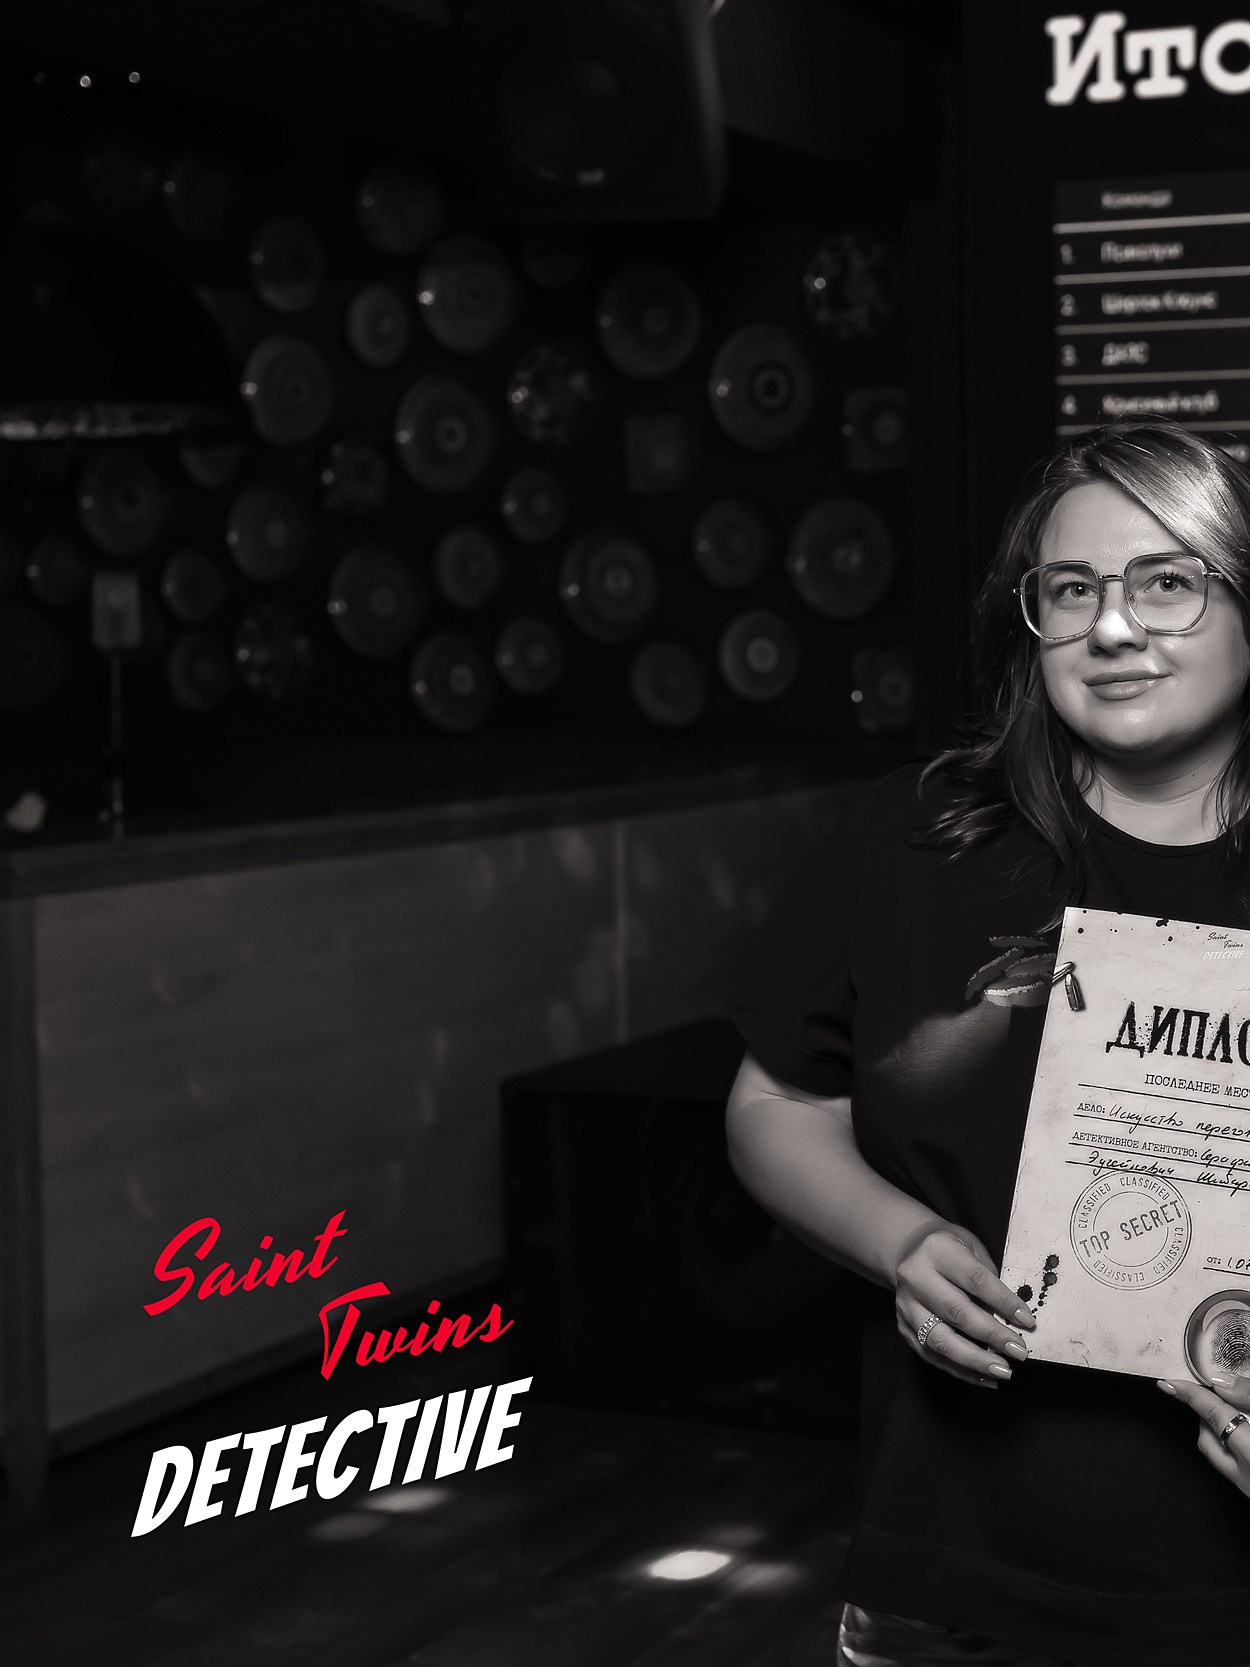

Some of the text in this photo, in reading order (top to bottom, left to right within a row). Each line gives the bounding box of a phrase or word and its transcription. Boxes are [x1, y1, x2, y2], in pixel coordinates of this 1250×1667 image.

[1144, 1073, 1220, 1095] ПОСЛЕДНЕЕ
[1077, 1102, 1106, 1114] ДЕЛО:
[1072, 1131, 1139, 1149] ДЕТЕКТИВНОЕ
[1141, 1142, 1198, 1158] АГЕНТСТВО:
[1120, 1176, 1170, 1201] CLASSIFIED
[1079, 1182, 1112, 1229] CLASSIFIED
[1079, 1199, 1182, 1258] TOP SECRET
[1153, 1227, 1184, 1274] CLASSIFIED
[1093, 1259, 1145, 1282] CLASSIFIED
